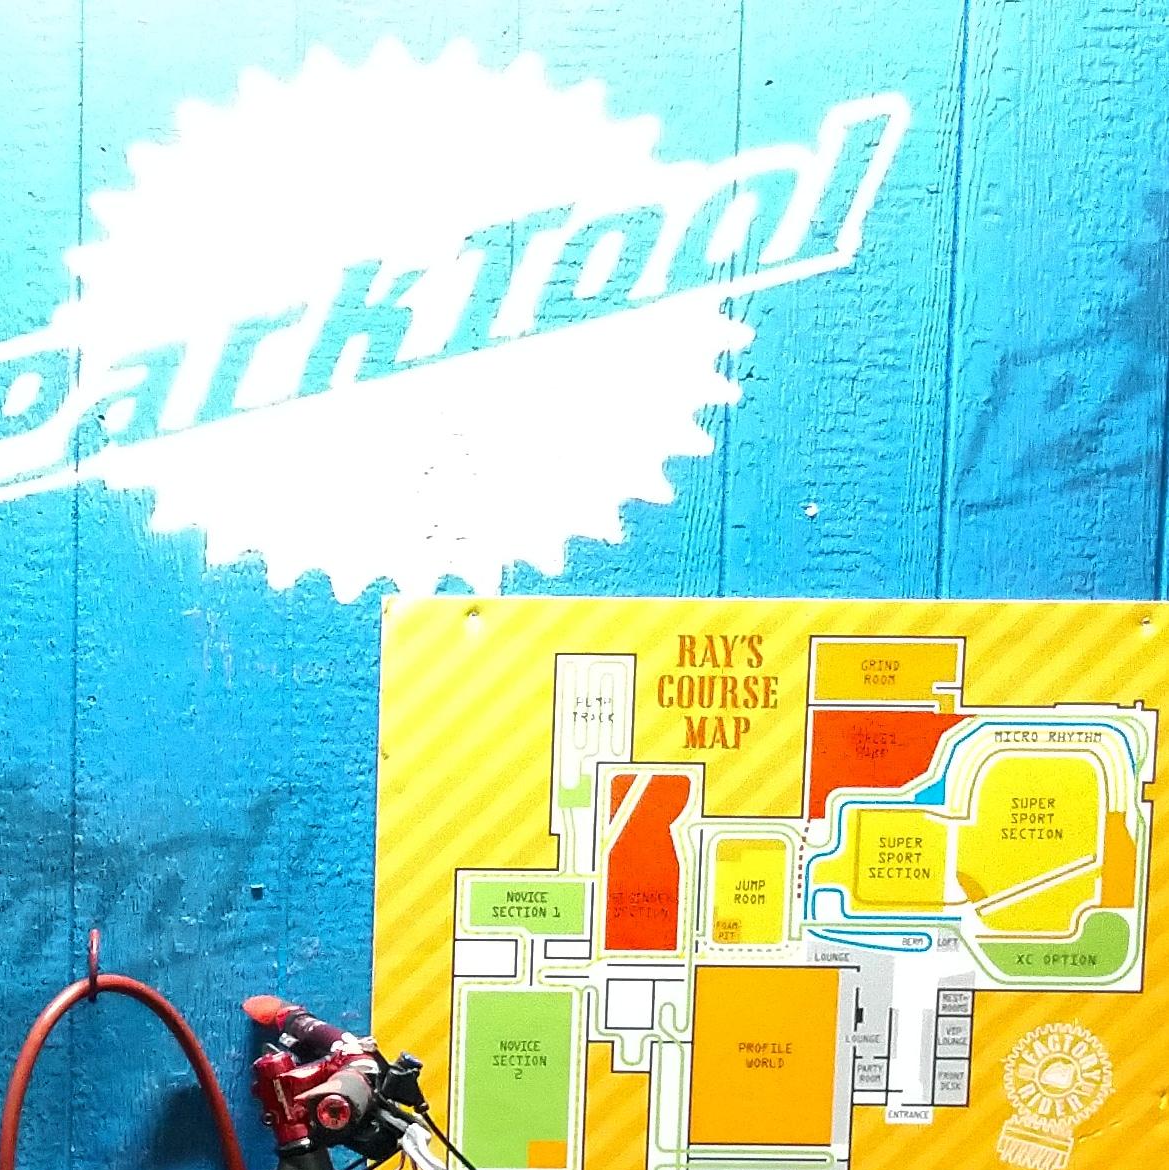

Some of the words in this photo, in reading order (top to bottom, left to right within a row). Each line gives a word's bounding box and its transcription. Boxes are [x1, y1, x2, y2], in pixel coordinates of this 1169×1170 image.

[678, 634, 763, 669] RAY'S
[861, 659, 900, 672] GRIND
[864, 674, 896, 686] ROOM
[657, 675, 779, 710] COURSE
[683, 716, 751, 751] MAP
[994, 730, 1039, 743] MICRO
[1048, 730, 1103, 743] RHYTHM
[1011, 797, 1056, 810] SUPER
[1010, 812, 1055, 825] SPORT
[1001, 827, 1064, 841] SECTION
[878, 836, 923, 849] SUPER
[877, 852, 922, 865] SPORT
[868, 867, 931, 879] SECTION
[734, 879, 766, 892] JUMP
[506, 891, 548, 903] NOVICE
[734, 893, 766, 905] ROOM
[491, 906, 546, 919] SECTION
[936, 937, 959, 948] LOFT
[814, 952, 851, 964] LOUNGE
[1014, 953, 1035, 966] XC
[1043, 953, 1097, 966] OPTION
[845, 1033, 881, 1044] LOUNGE
[938, 1036, 969, 1046] LOUNGE
[499, 1040, 541, 1052] NOVICE
[738, 1042, 793, 1054] PROFILE
[492, 1055, 547, 1067] SECTION
[746, 1057, 785, 1069] WORLD
[514, 1069, 523, 1081] 2
[857, 1064, 883, 1074] PARTY
[859, 1074, 882, 1083] ROOM
[940, 1081, 962, 1091] DESK
[888, 1110, 930, 1120] ENTRANCE
